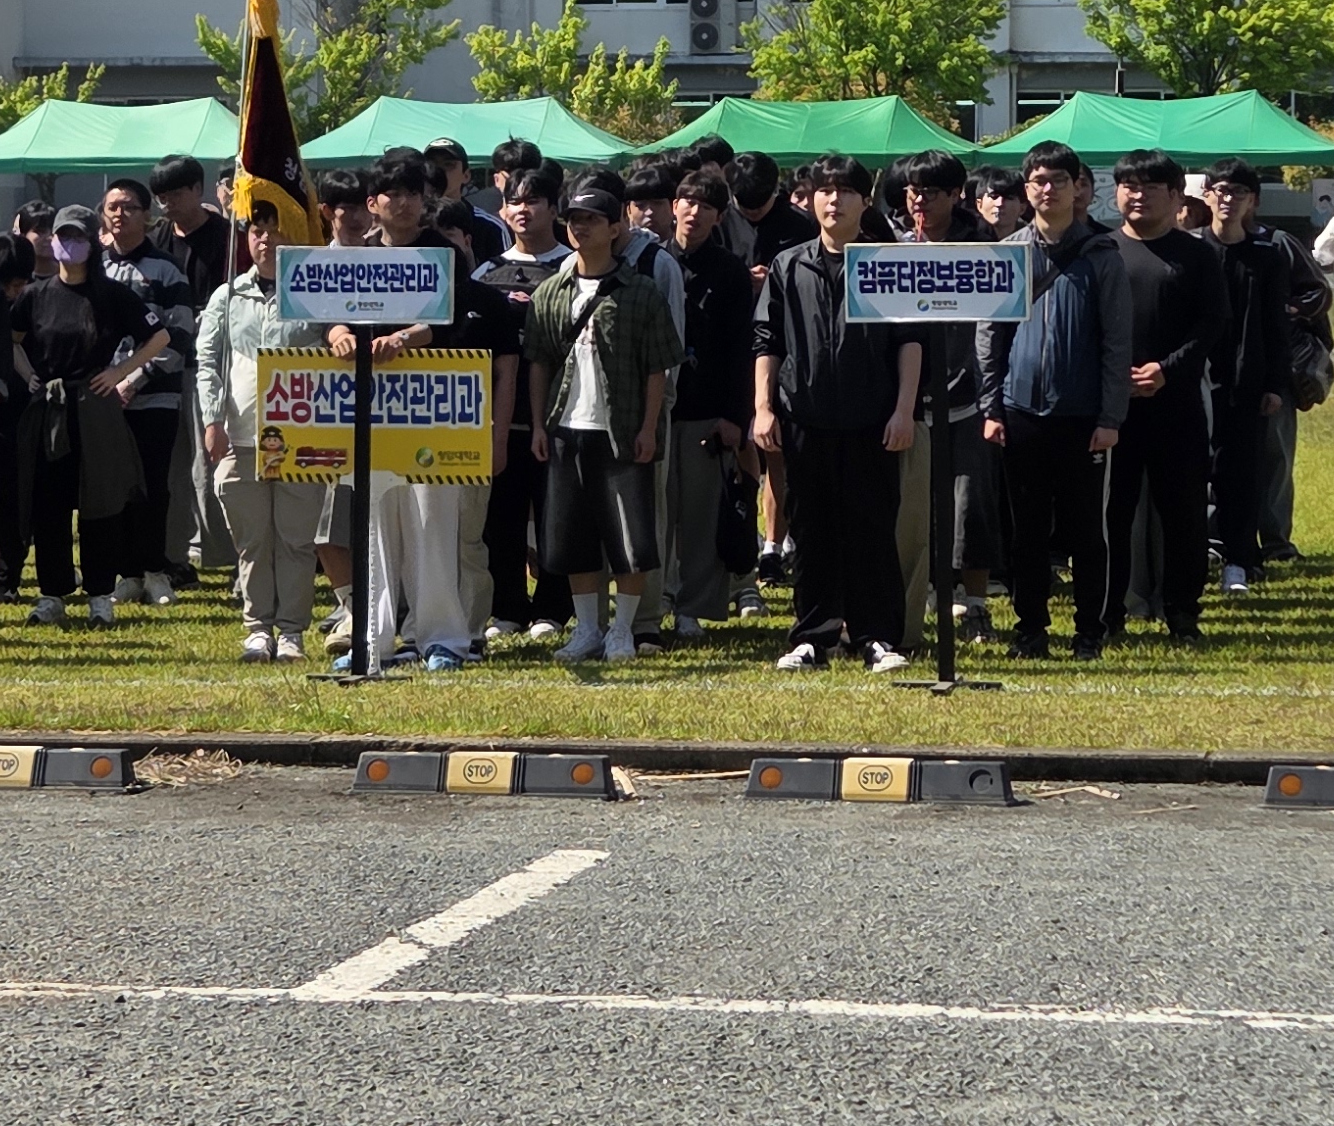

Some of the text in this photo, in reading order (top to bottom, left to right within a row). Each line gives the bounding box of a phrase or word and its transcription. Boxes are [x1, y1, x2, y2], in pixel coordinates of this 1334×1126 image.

[290, 263, 439, 292] 소방산업안전관리과
[857, 260, 1015, 294] 컴퓨터정보융합과
[467, 764, 493, 777] STOP
[862, 772, 889, 785] STOP
